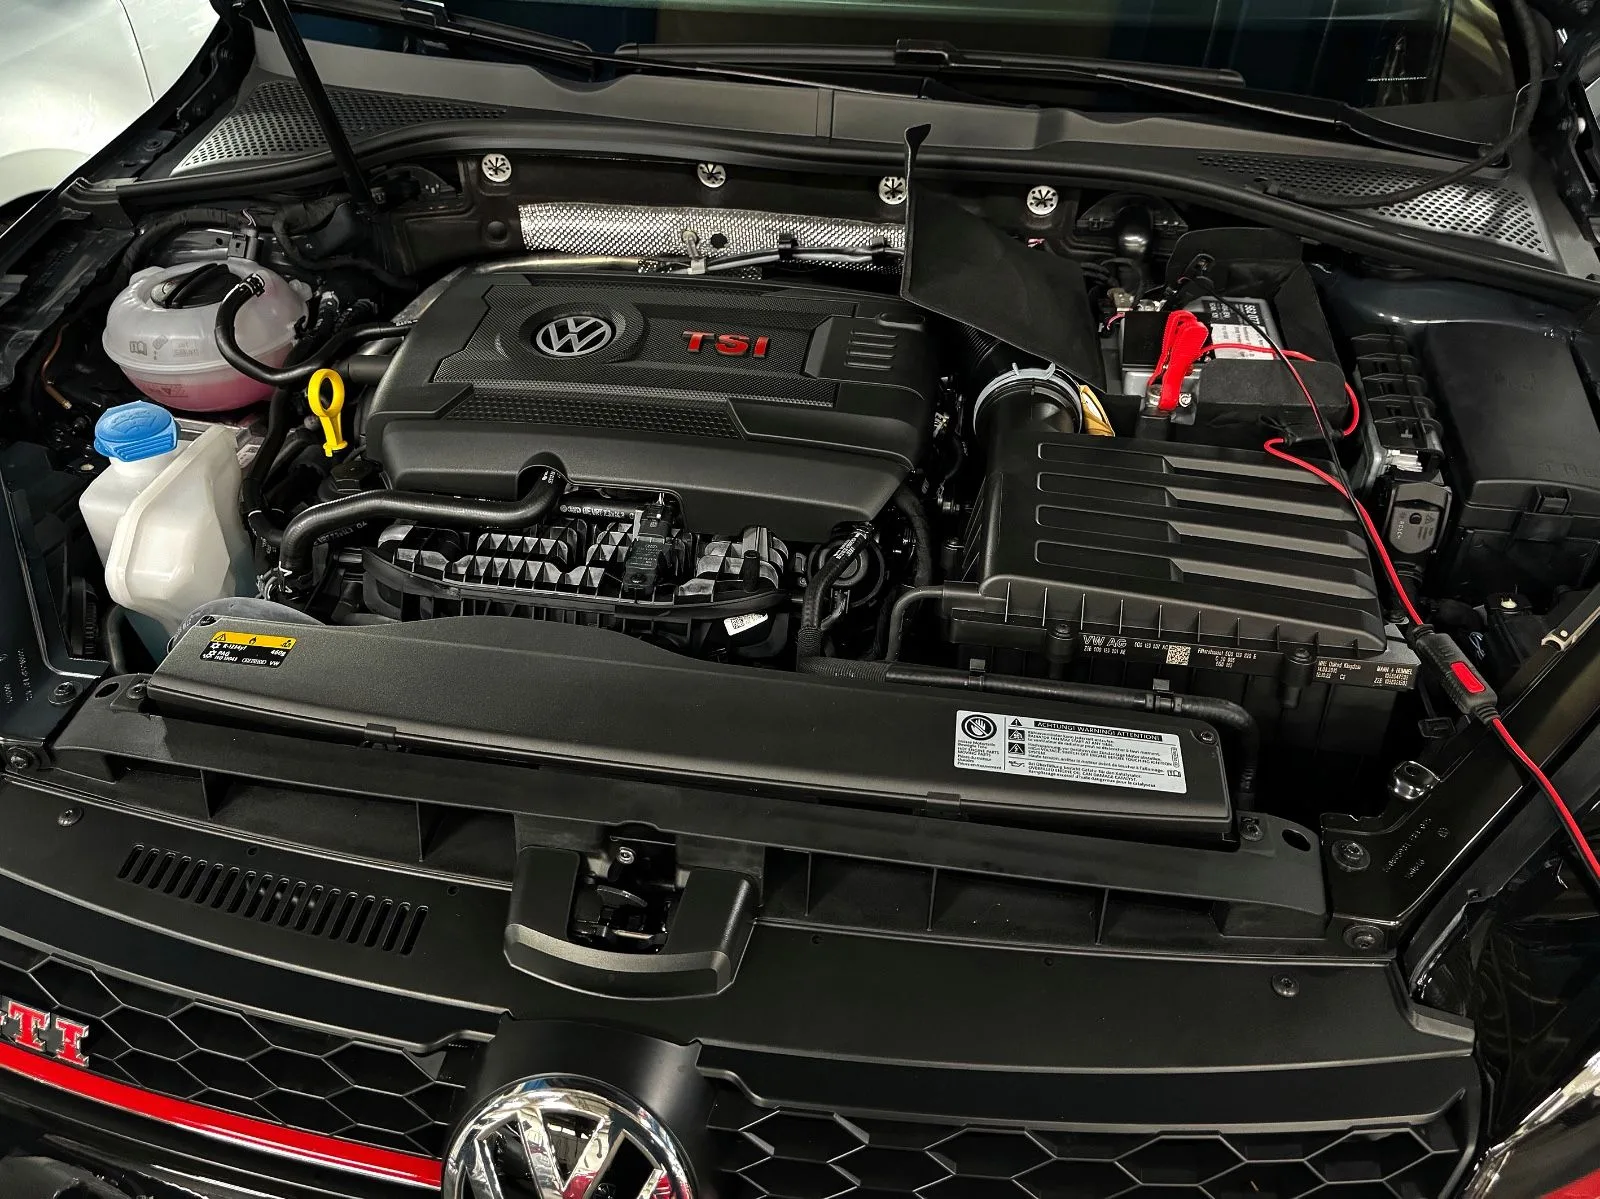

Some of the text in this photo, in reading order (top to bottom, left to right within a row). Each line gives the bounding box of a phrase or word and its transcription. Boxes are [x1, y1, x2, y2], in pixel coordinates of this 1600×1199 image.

[682, 330, 769, 358] TSI
[1083, 635, 1127, 648] VW AG
[1037, 722, 1159, 740] ACHTUNG! WARNING! ATTENTION!
[0, 1000, 90, 1068] TI
